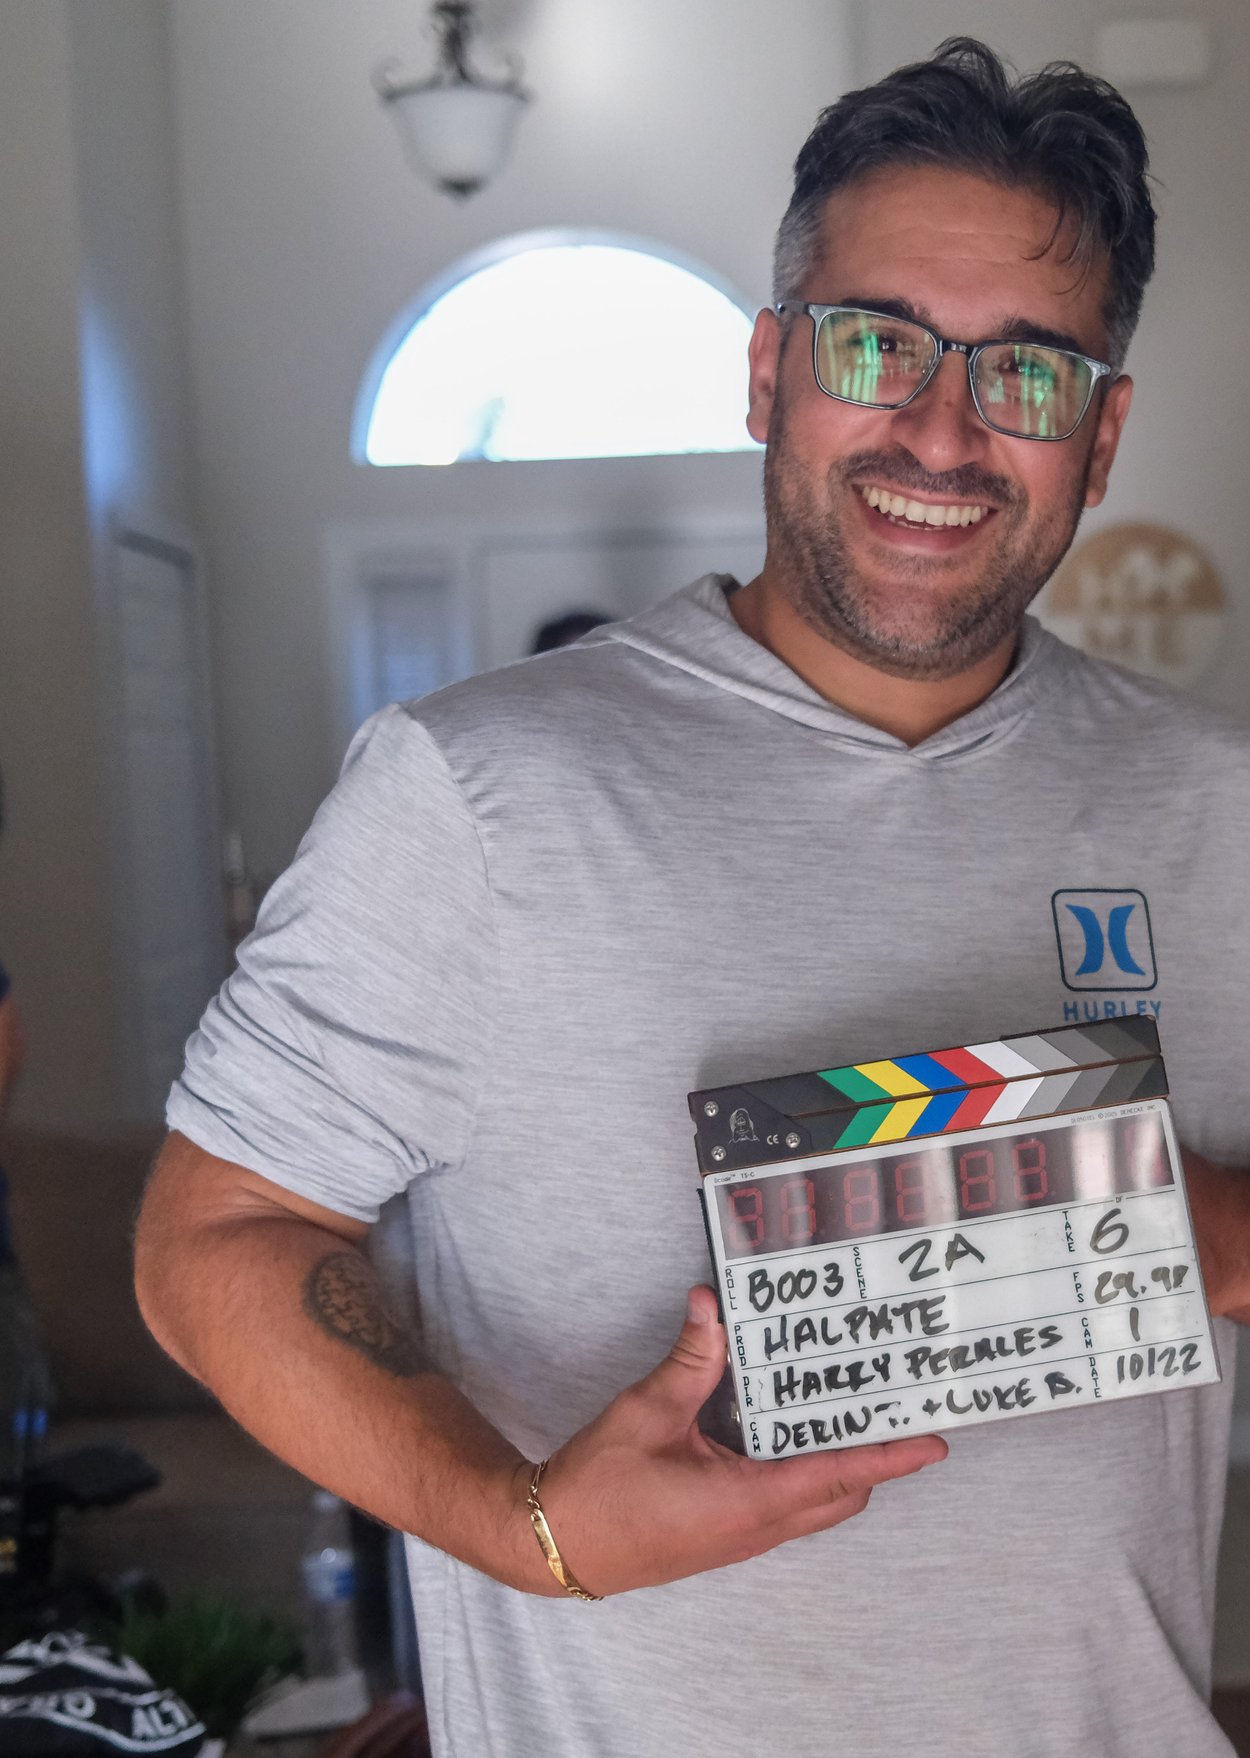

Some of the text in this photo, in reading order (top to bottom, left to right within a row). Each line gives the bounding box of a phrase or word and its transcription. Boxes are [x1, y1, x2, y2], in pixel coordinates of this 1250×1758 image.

[1062, 1210, 1075, 1252] TAKE
[1090, 1207, 1130, 1255] 6
[853, 1246, 868, 1300] SCENE
[898, 1232, 986, 1282] 2A
[725, 1268, 738, 1311] ROLL
[747, 1261, 845, 1313] B003
[1072, 1271, 1084, 1303] FPS
[734, 1324, 747, 1367] PROD
[1081, 1316, 1093, 1348] CAM
[743, 1375, 754, 1408] DIR
[773, 1352, 892, 1408] HARRY
[1089, 1356, 1102, 1398] DATE
[749, 1420, 761, 1453] CAM
